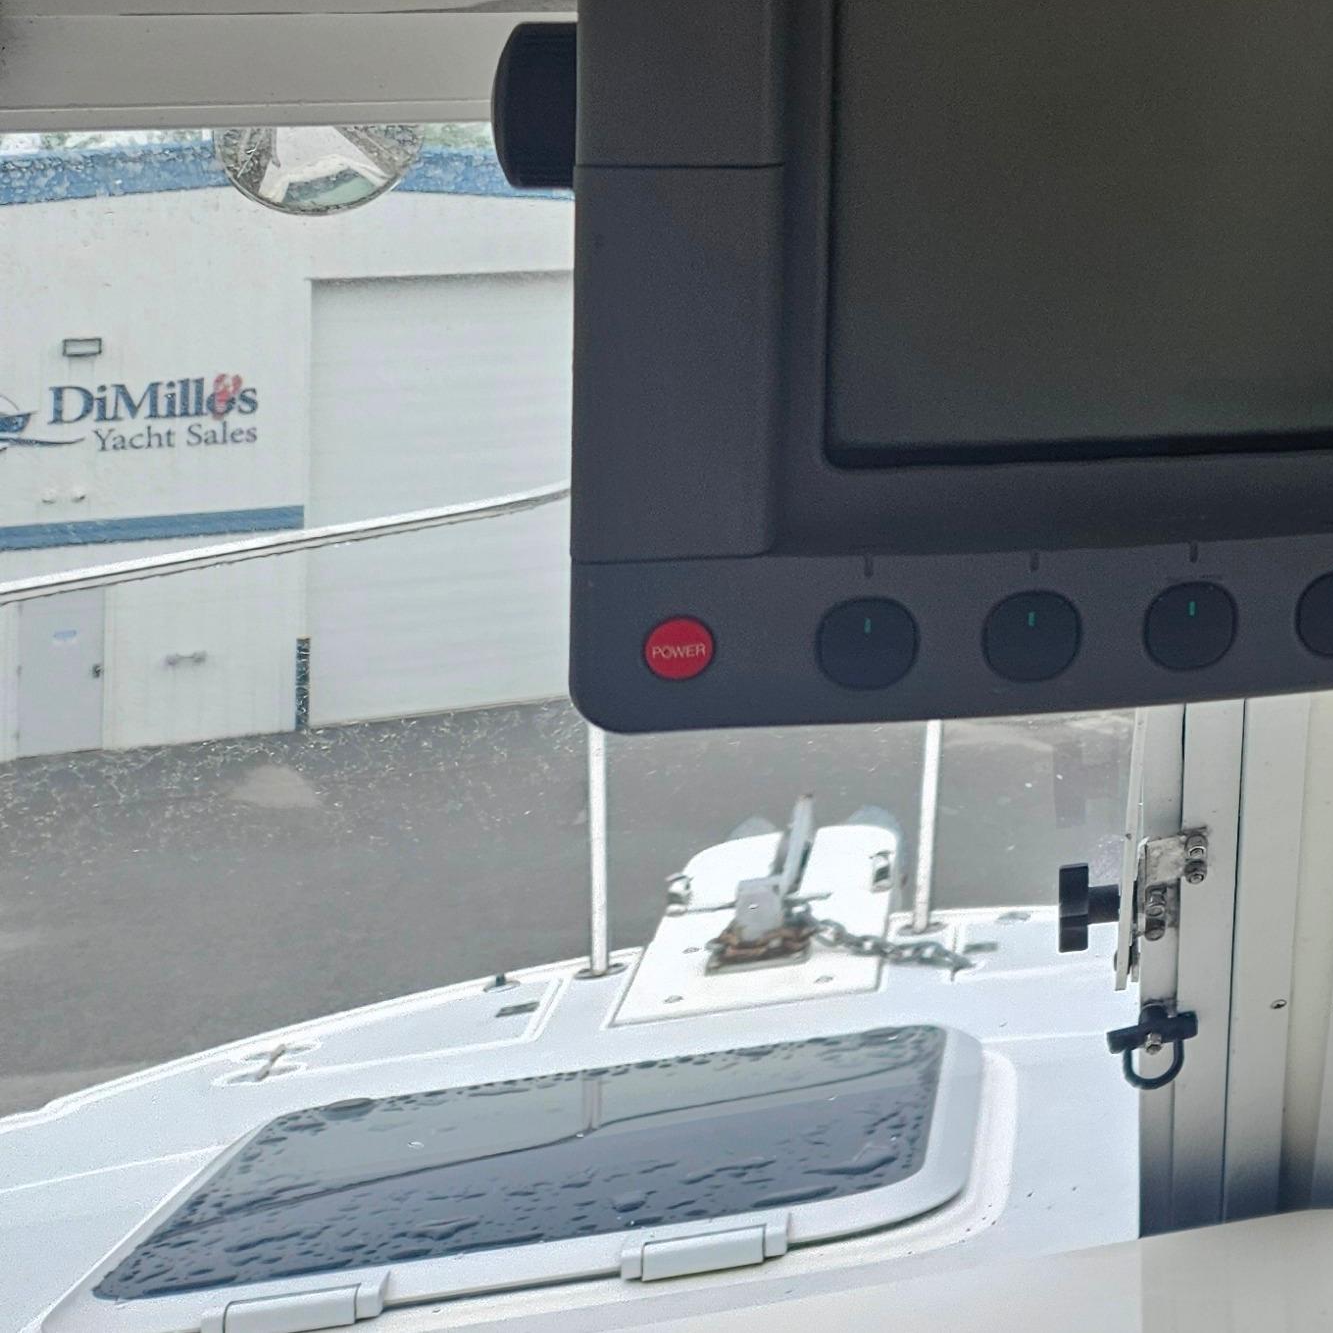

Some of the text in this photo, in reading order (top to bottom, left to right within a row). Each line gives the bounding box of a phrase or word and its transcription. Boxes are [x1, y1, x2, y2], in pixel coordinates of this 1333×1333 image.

[93, 421, 257, 452] Yacht Sales
[652, 642, 706, 660] POWER
